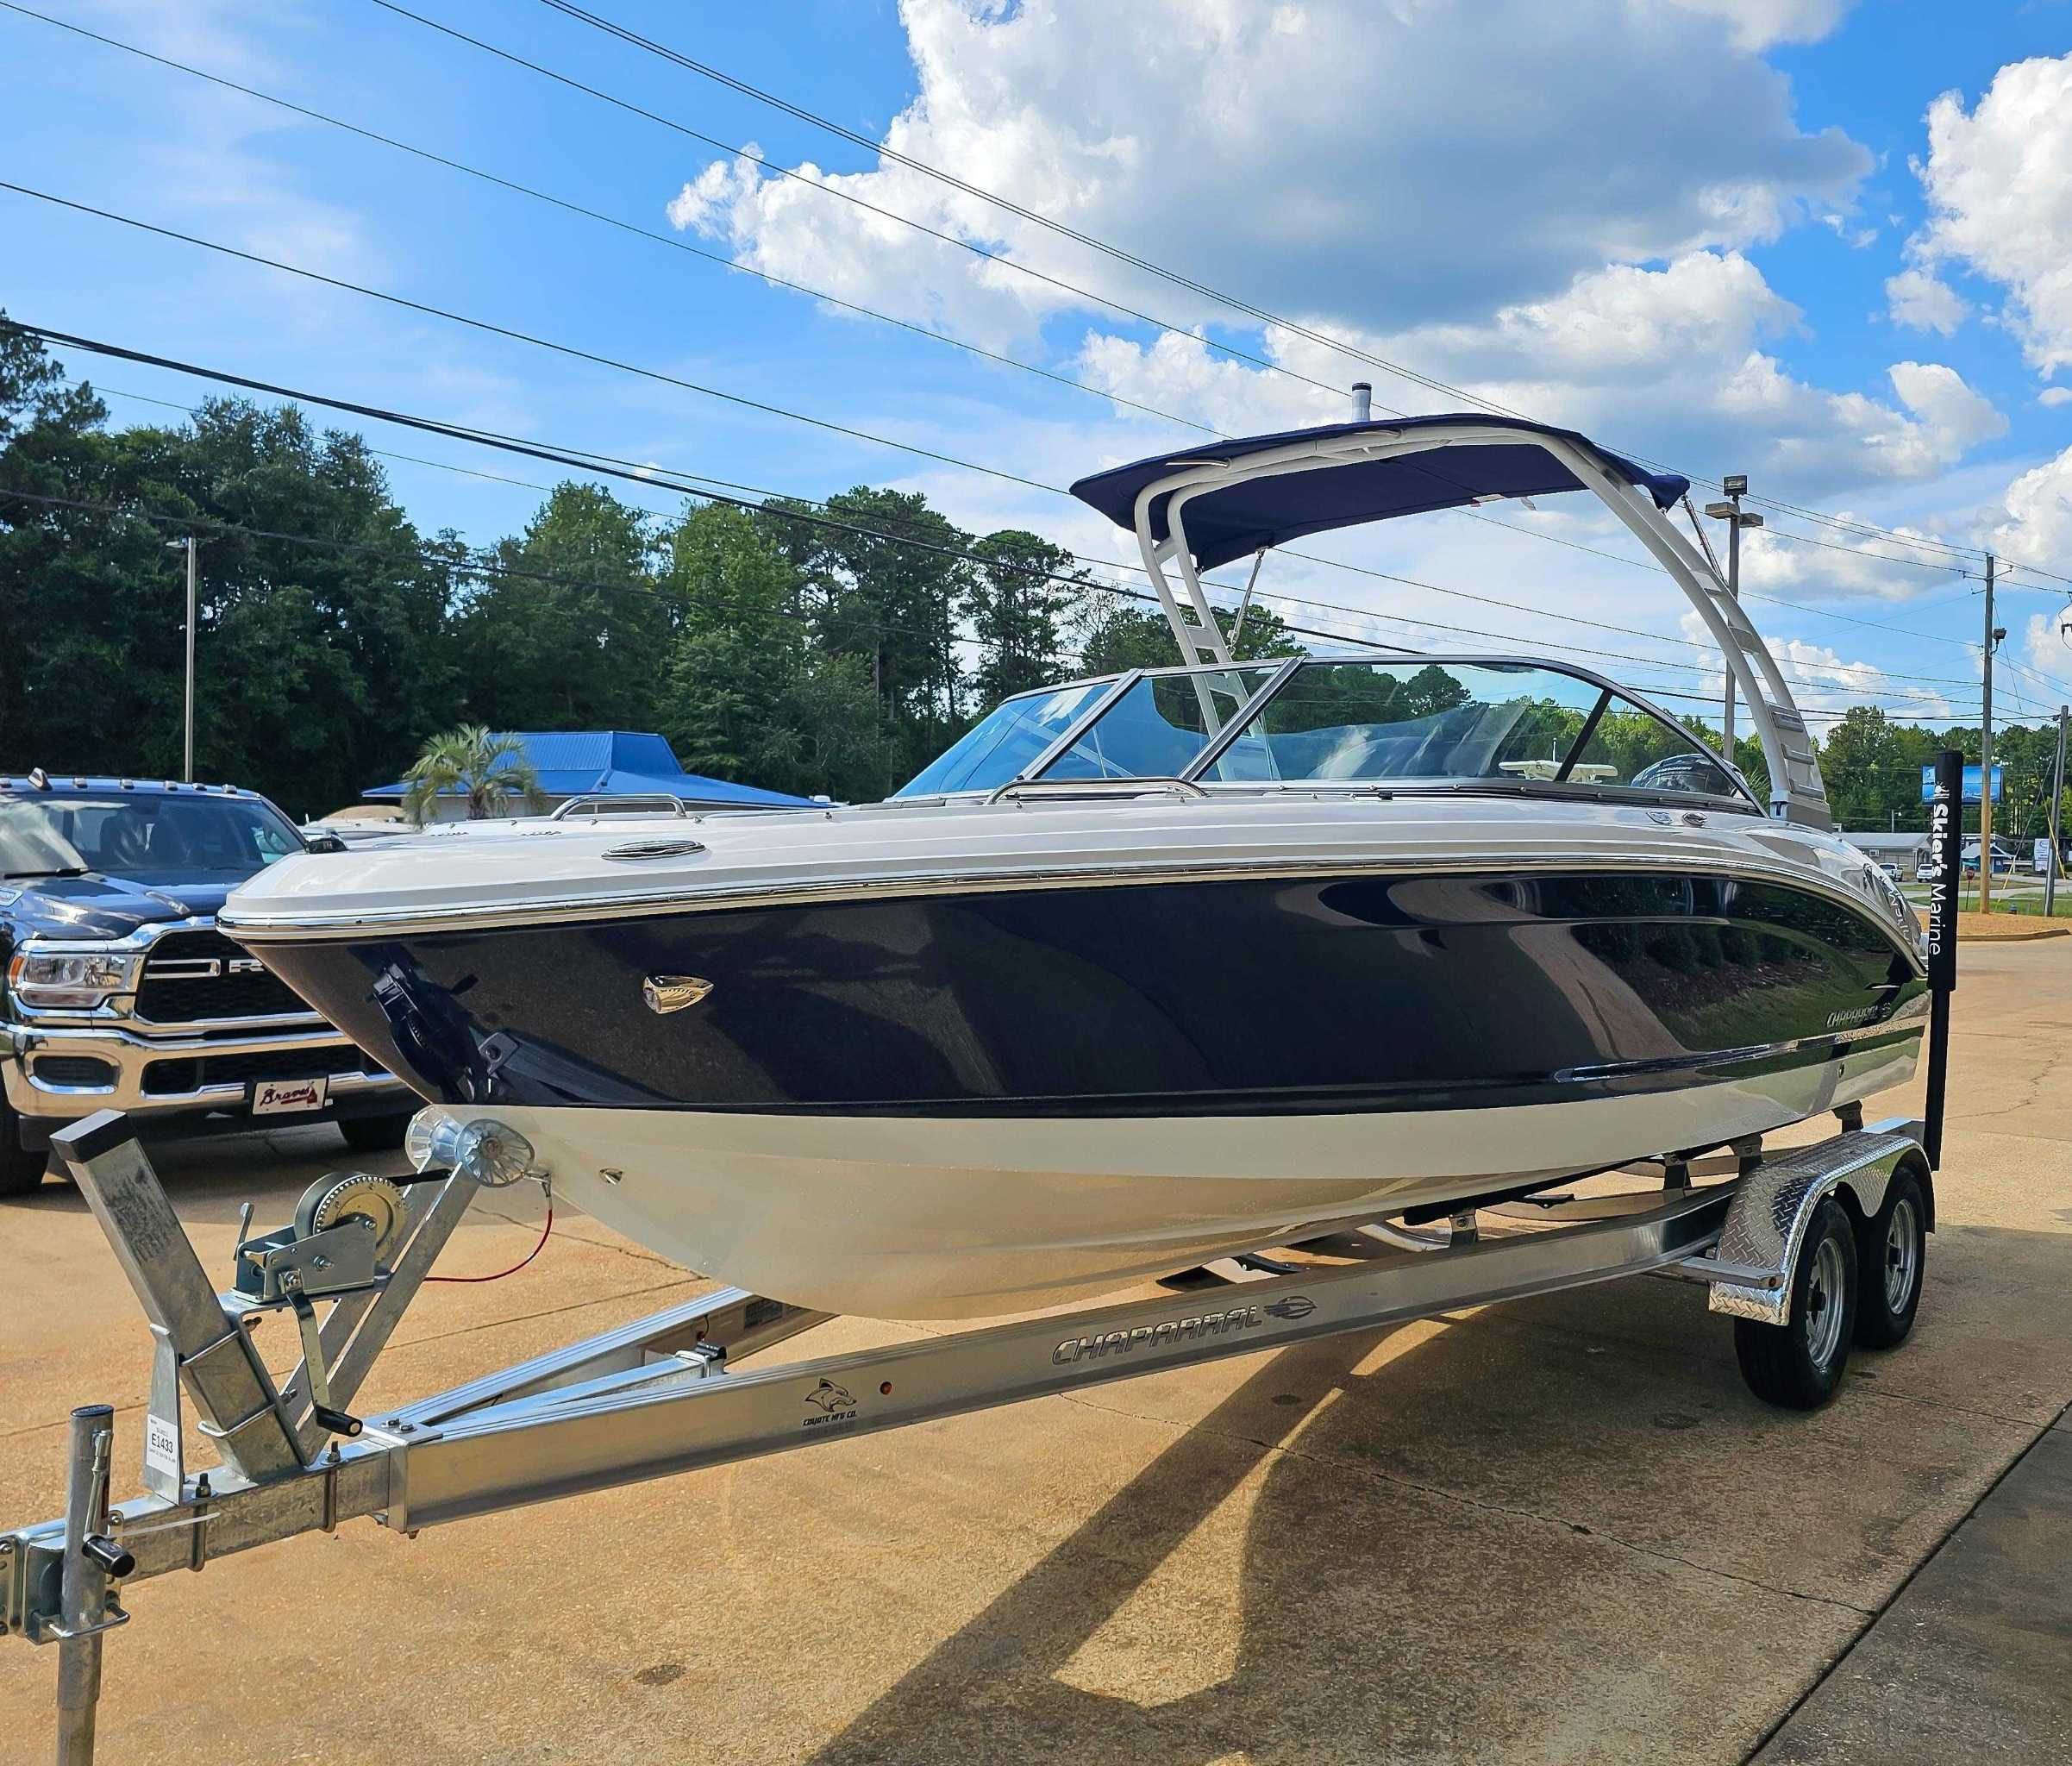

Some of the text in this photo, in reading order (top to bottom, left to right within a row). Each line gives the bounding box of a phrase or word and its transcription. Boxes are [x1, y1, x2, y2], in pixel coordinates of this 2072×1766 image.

[1929, 803, 1949, 955] Skier's Marine
[1052, 1305, 1262, 1365] CHAPARRAL
[151, 1432, 173, 1454] E1433
